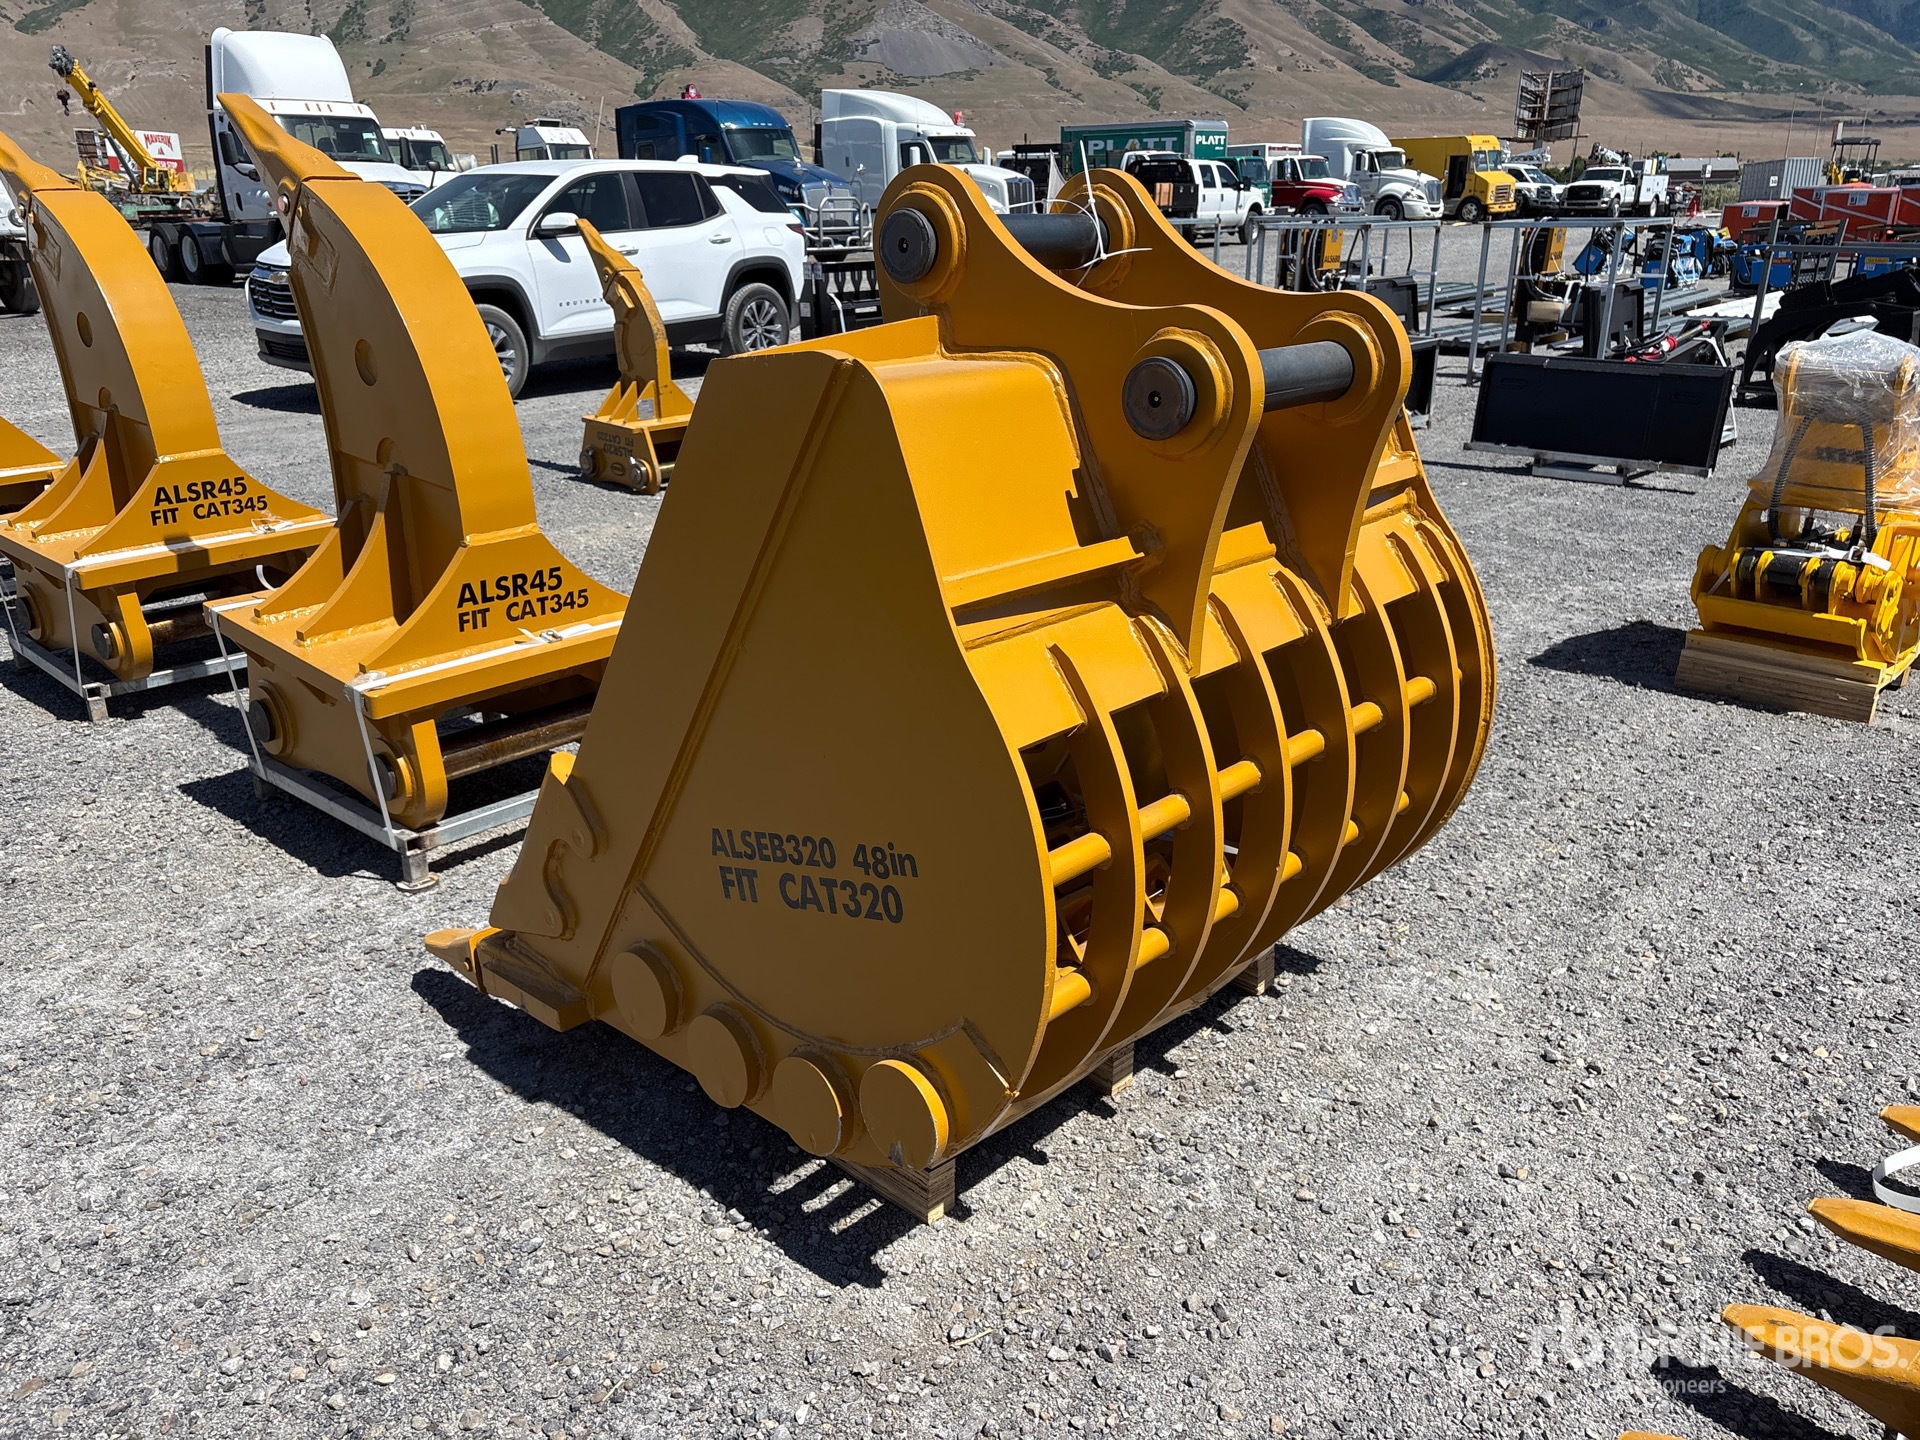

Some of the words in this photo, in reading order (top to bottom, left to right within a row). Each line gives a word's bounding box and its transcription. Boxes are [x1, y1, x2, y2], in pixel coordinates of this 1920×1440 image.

[1087, 137, 1178, 156] PLATT
[1195, 135, 1226, 145] PLATT
[154, 476, 247, 507] ALSR45
[150, 507, 179, 527] FIT
[193, 495, 268, 520] CAT345
[457, 566, 563, 609] ALSR45
[458, 607, 490, 633] FIT
[506, 588, 589, 622] CAT345
[711, 828, 836, 869] ALSEB320
[853, 841, 918, 880] 48in
[719, 866, 758, 903] FIT
[779, 873, 904, 924] CAT320
